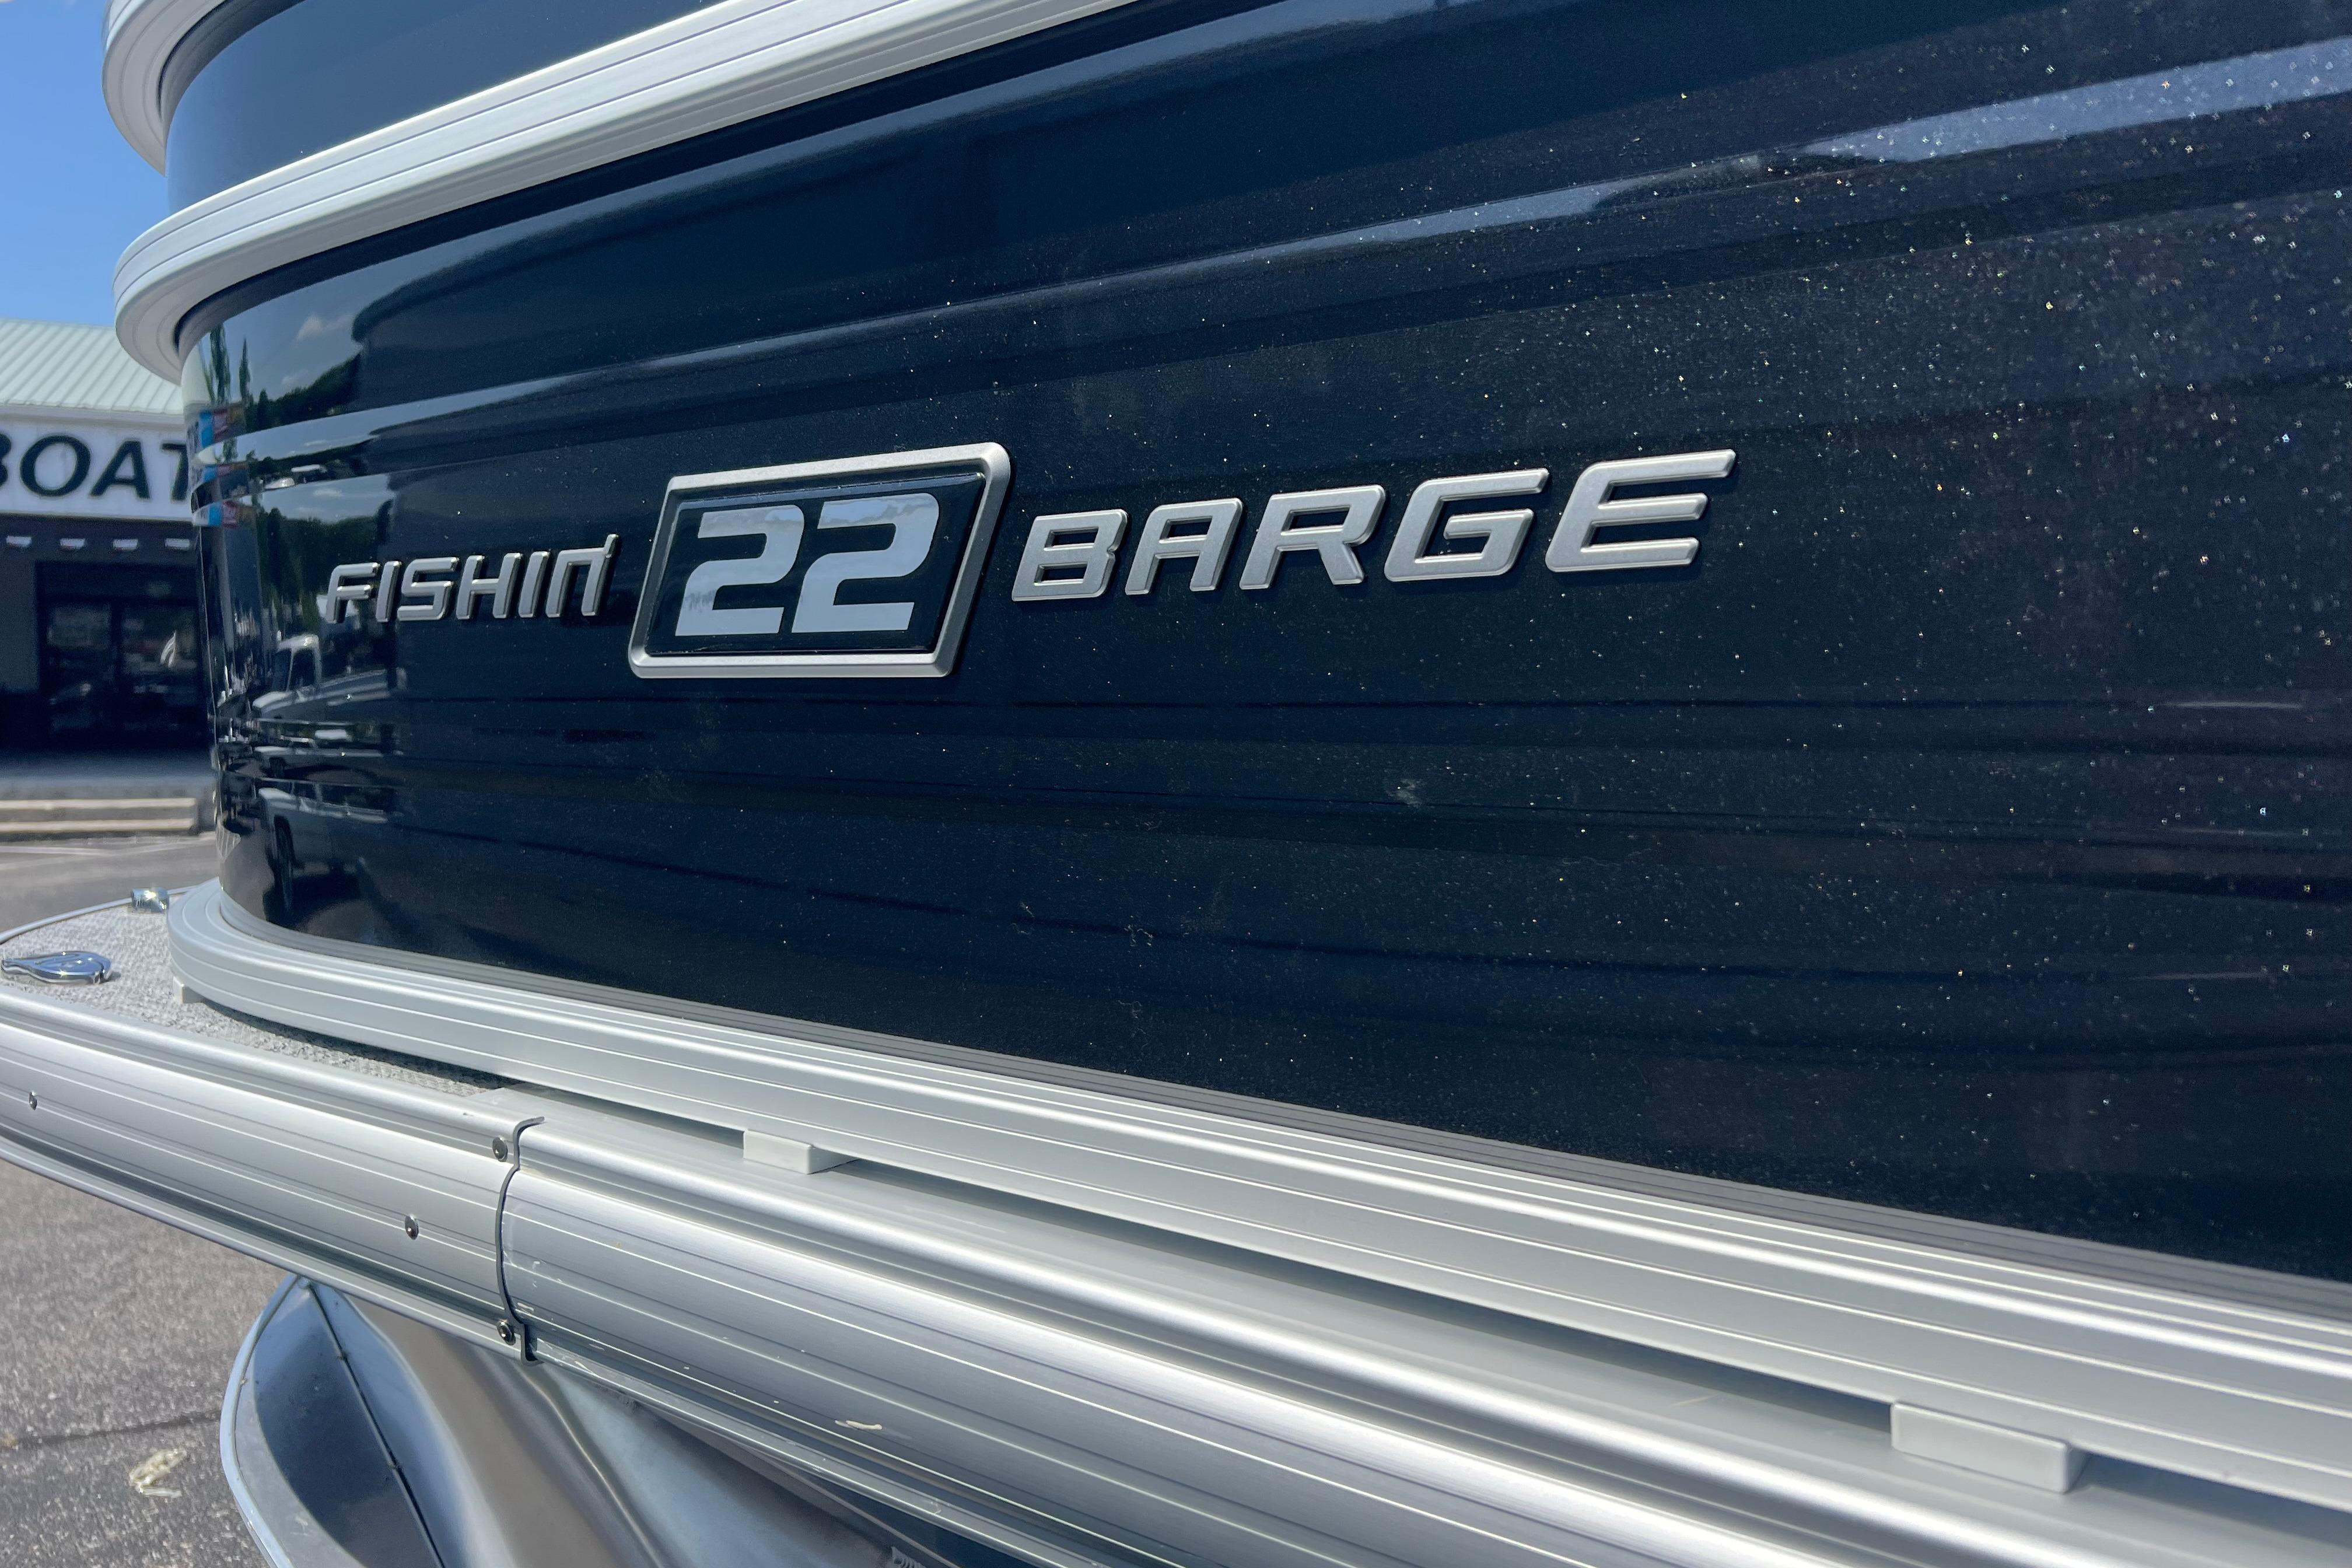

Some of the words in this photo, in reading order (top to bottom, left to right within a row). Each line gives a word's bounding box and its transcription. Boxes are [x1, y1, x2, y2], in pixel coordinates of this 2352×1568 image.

[0, 433, 188, 501] OAT
[675, 493, 939, 636] 22
[1012, 449, 1736, 601] BARGE
